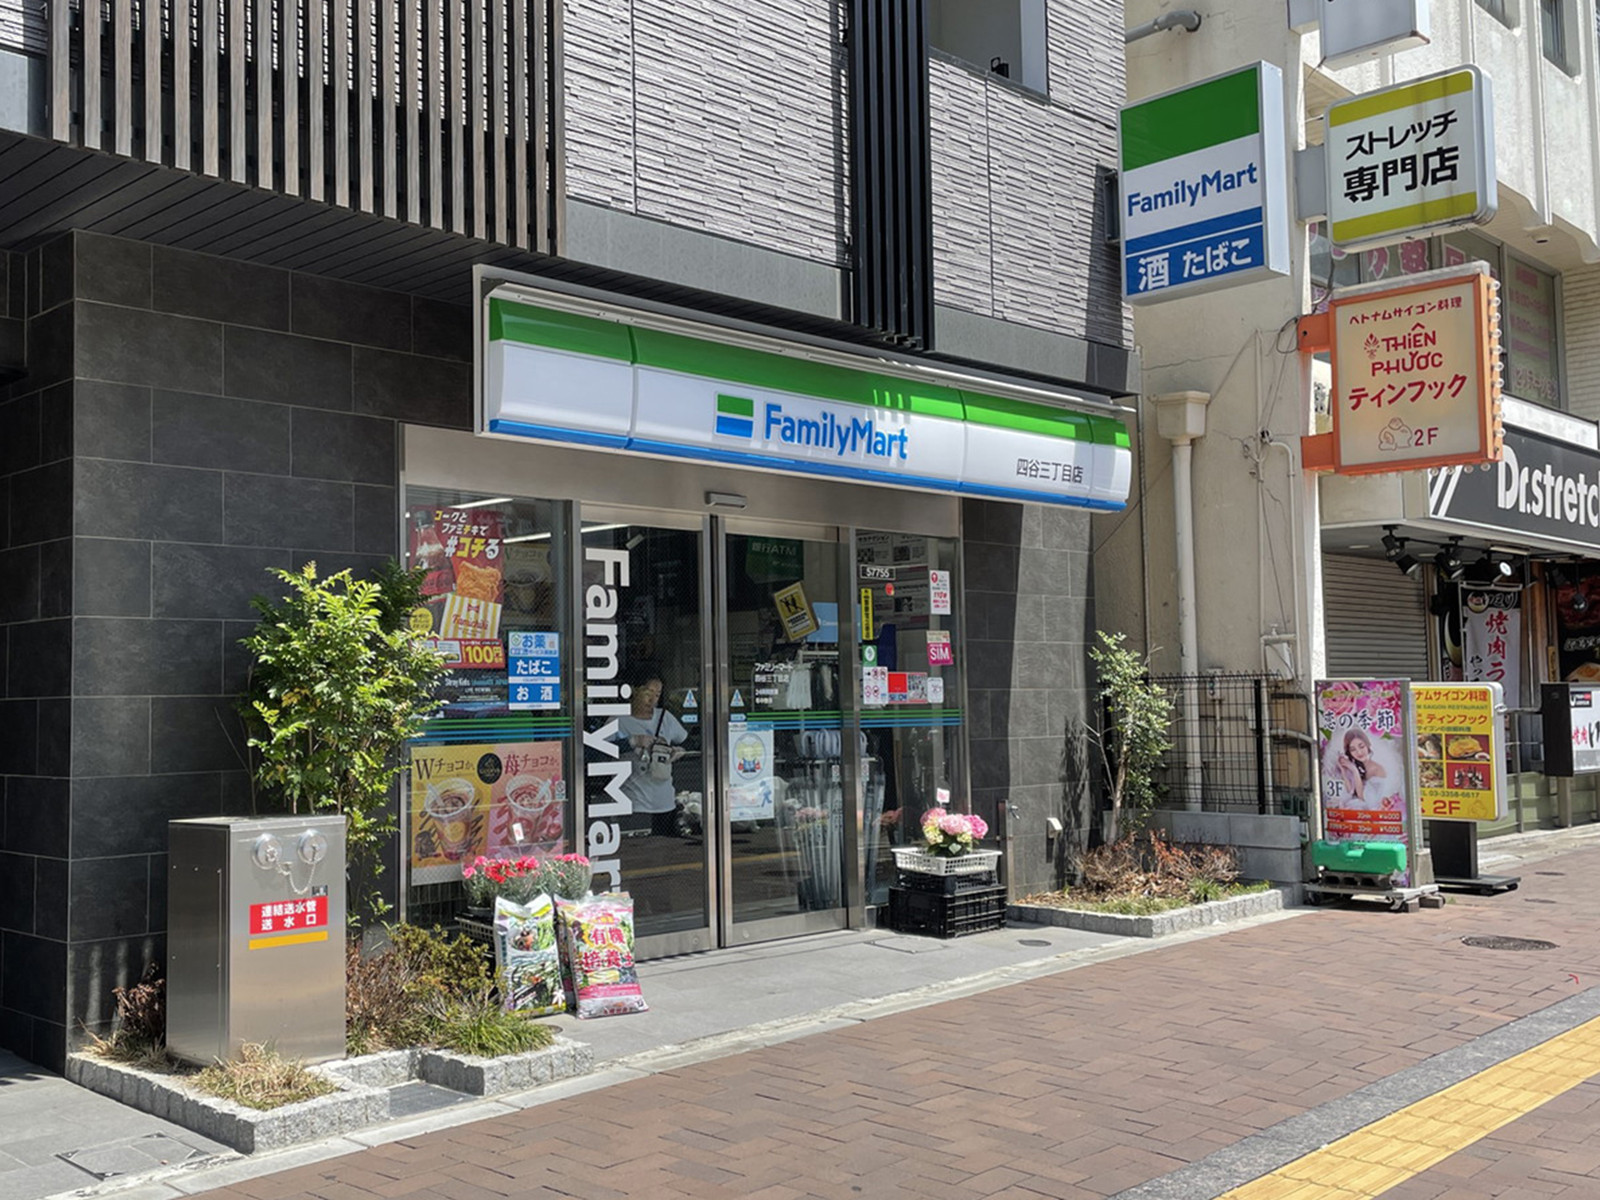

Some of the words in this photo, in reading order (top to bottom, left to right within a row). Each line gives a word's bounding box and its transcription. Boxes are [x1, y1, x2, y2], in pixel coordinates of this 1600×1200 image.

[1346, 109, 1458, 161] ストレッチ
[1343, 145, 1459, 203] 専門店
[1127, 162, 1258, 217] FamilyMart
[1138, 252, 1170, 291] 酒
[1182, 238, 1252, 278] たばこ
[1348, 373, 1468, 411] ティンフック
[764, 402, 909, 459] FamilyMart
[1414, 427, 1439, 447] 2F
[1016, 458, 1084, 483] 四谷三丁目店
[1498, 444, 1600, 528] Dr.stretc
[434, 510, 468, 523] コークと
[445, 535, 500, 560] #コチる
[929, 648, 950, 660] SIM
[1485, 609, 1509, 683] 焼肉ラ
[516, 659, 552, 675] たばこ
[582, 547, 633, 893] FamilyMar
[1323, 709, 1394, 730] 恋の季節
[1426, 713, 1488, 725] ティンフック
[1327, 781, 1343, 797] 3F
[1432, 800, 1461, 815] 2F
[260, 899, 317, 918] 連結送水管
[260, 913, 317, 931] 送水口
[591, 926, 625, 946] 有機
